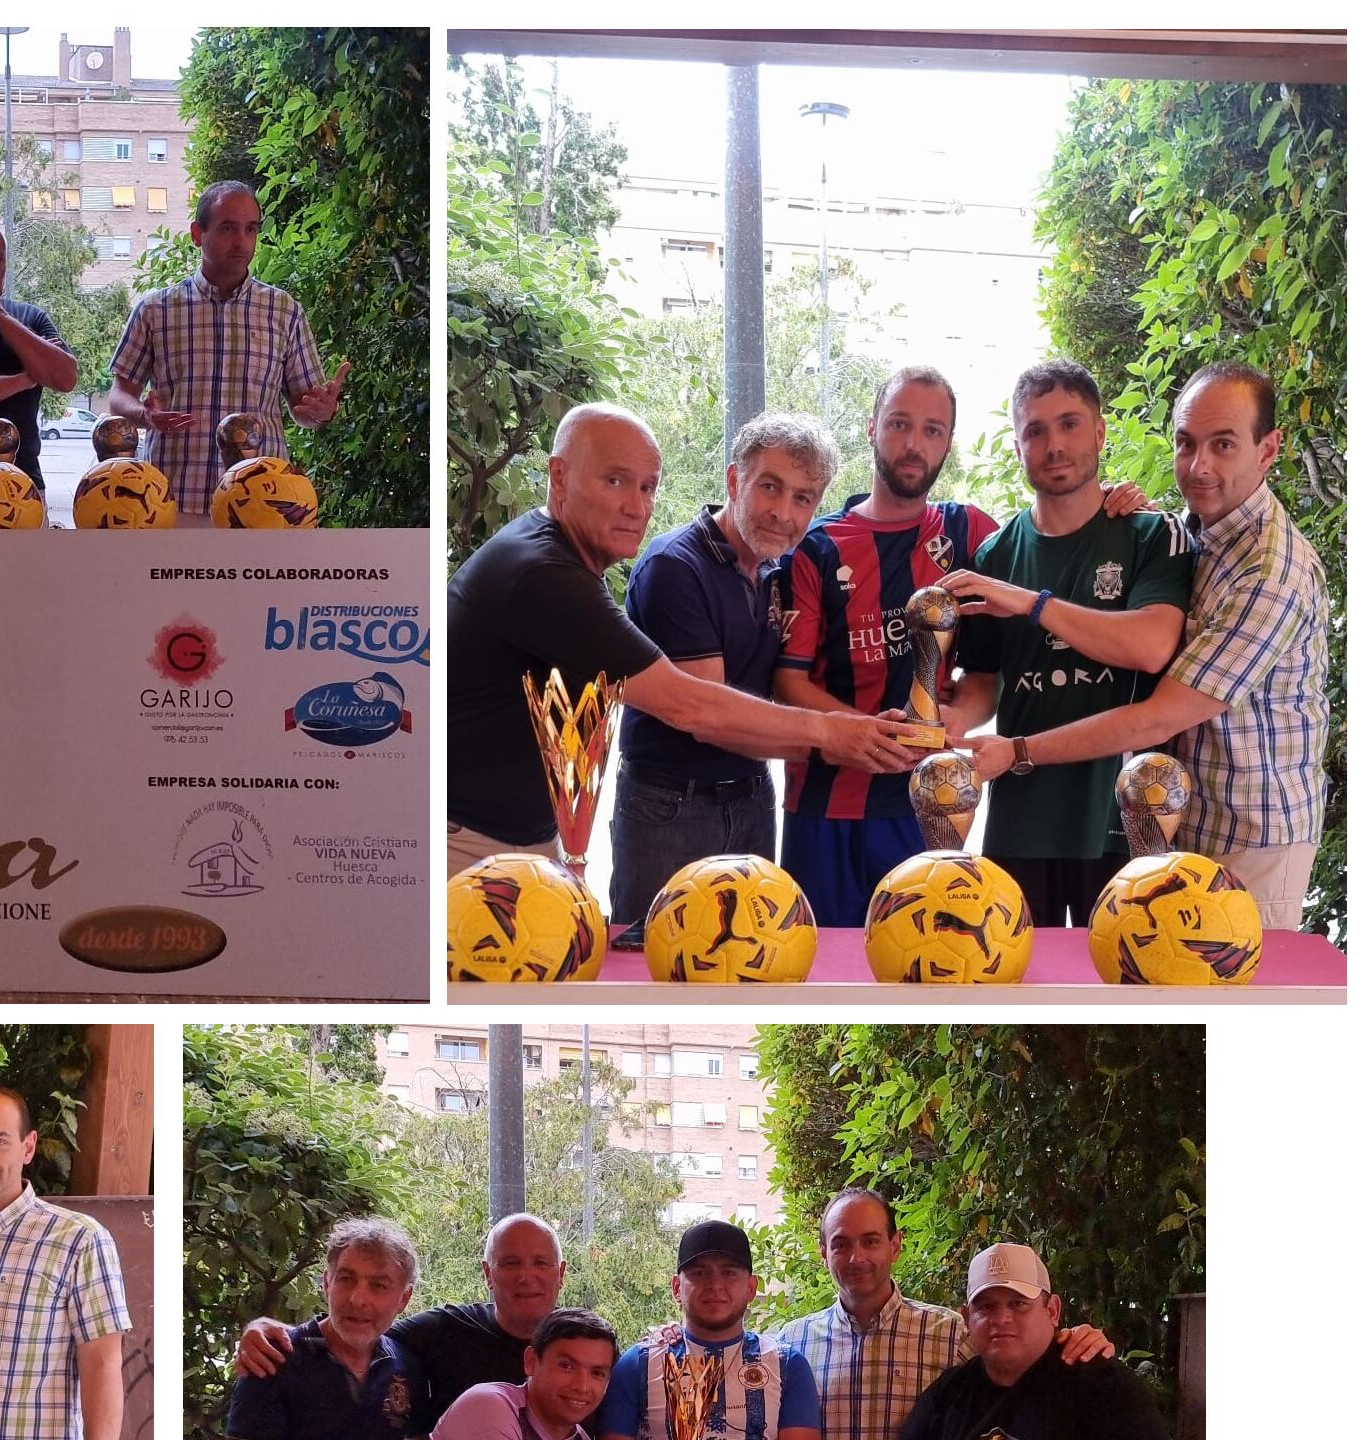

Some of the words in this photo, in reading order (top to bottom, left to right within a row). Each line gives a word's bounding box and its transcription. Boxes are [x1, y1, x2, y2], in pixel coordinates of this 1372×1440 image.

[150, 568, 237, 580] EMPRESAS
[242, 568, 389, 580] COLABORADORAS
[310, 605, 419, 617] DISTRIBUCIONES
[264, 607, 420, 655] blasco
[139, 689, 234, 709] GARIJO
[321, 689, 339, 703] La
[307, 698, 386, 718] Coruñesa
[147, 776, 216, 788] EMPRESA
[221, 776, 299, 789] SOLIDARIA
[303, 778, 340, 790] CON:
[314, 848, 347, 860] VIDA
[350, 848, 396, 860] NUEVA
[333, 861, 378, 872] Huesca
[295, 872, 344, 884] Centros
[347, 872, 363, 885] de
[366, 873, 417, 888] Acogida
[79, 922, 145, 949] desde
[151, 924, 208, 951] 1993
